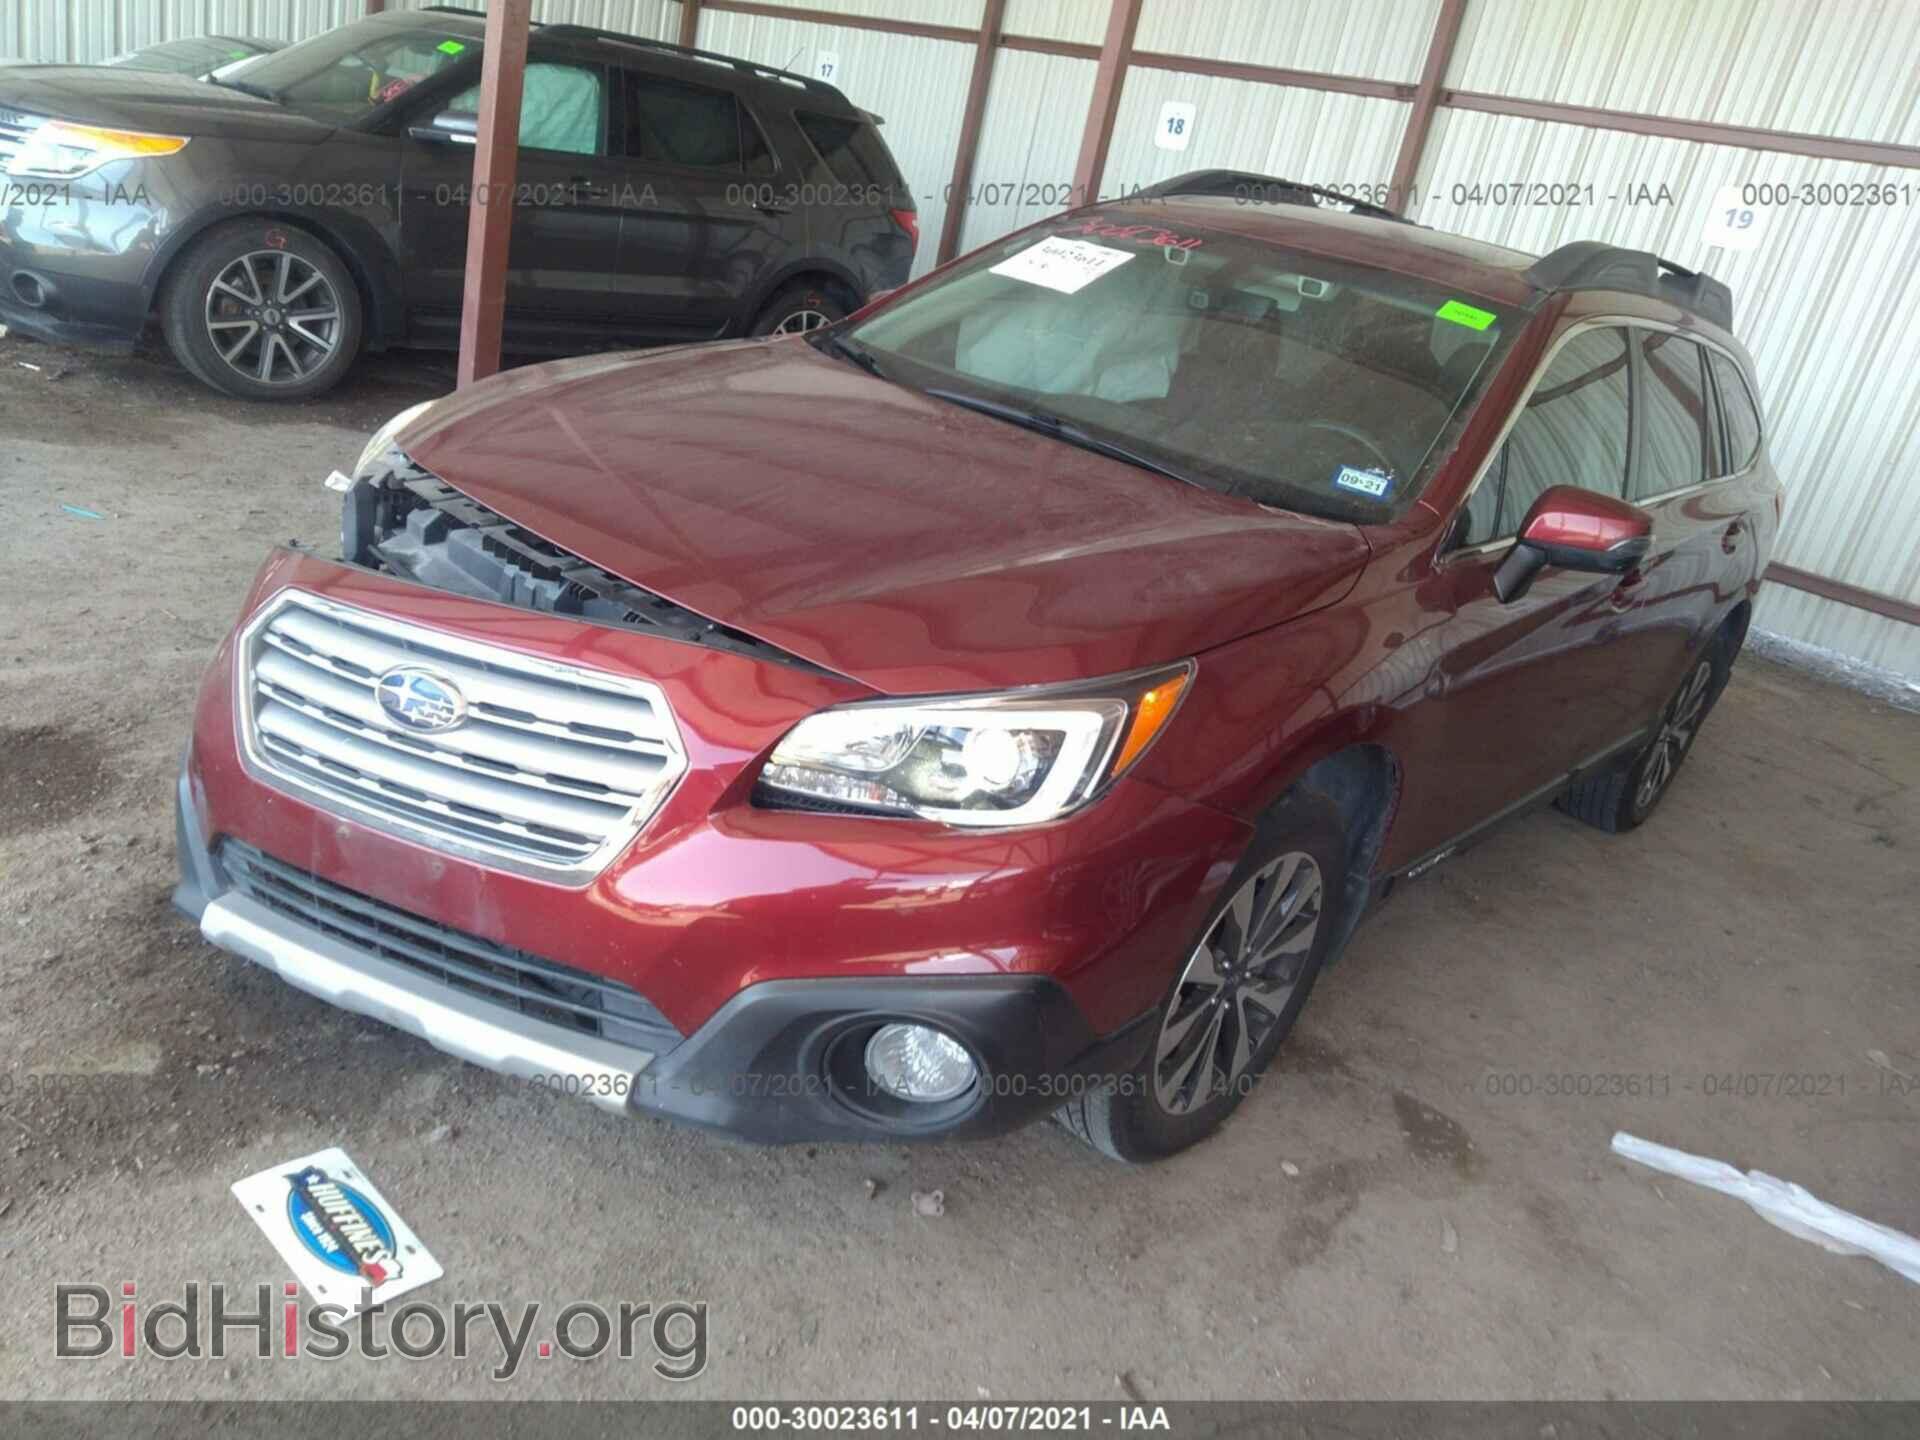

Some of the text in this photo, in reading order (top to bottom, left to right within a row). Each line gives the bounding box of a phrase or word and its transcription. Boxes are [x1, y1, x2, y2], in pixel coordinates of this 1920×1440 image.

[821, 63, 834, 78] 17
[1167, 116, 1185, 135] 18
[1725, 207, 1755, 229] 19
[307, 1182, 390, 1264] HUFFINES
